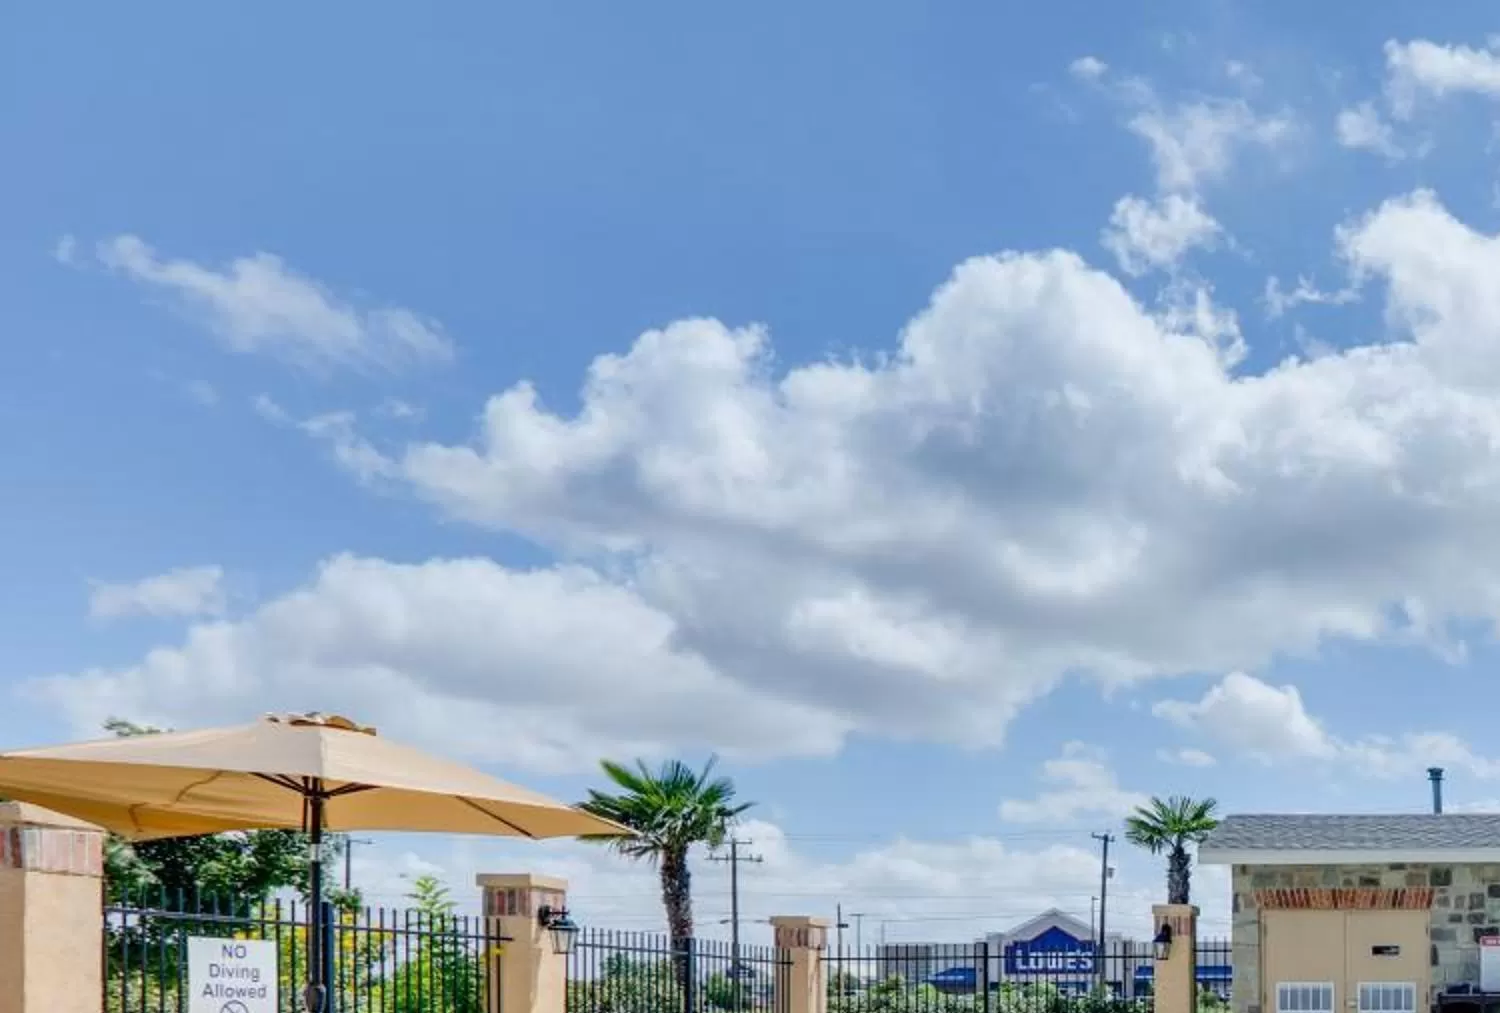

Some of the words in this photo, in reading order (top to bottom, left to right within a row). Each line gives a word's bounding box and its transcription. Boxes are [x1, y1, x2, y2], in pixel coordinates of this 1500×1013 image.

[221, 944, 247, 959] NO
[209, 963, 260, 983] Diving
[203, 983, 267, 999] Allowed
